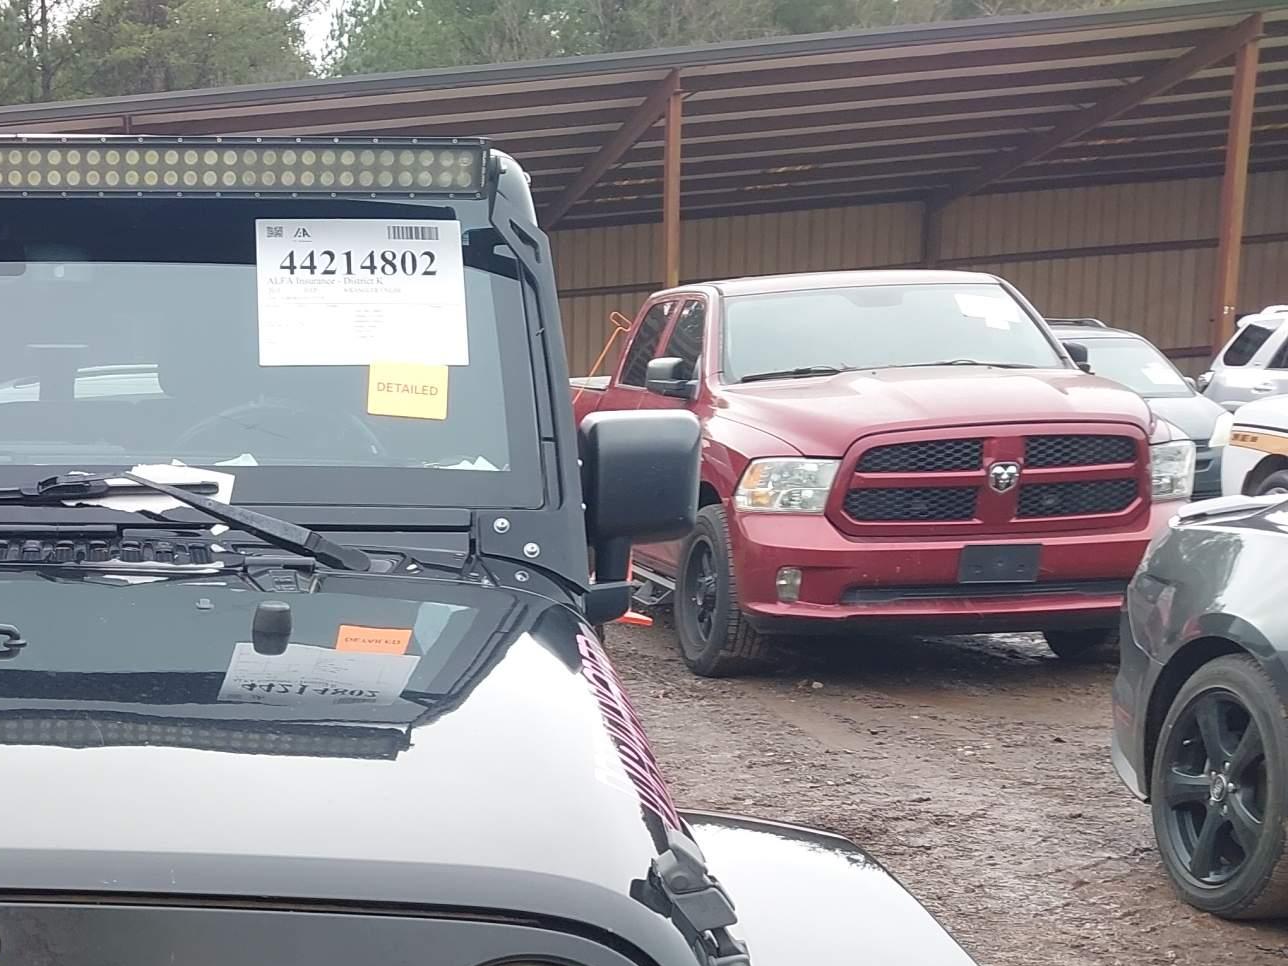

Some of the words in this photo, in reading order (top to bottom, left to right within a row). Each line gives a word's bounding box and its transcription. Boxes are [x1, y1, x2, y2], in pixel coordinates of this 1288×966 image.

[279, 249, 438, 276] 44214802
[268, 277, 293, 285] ALFA
[376, 381, 439, 397] DETAILED
